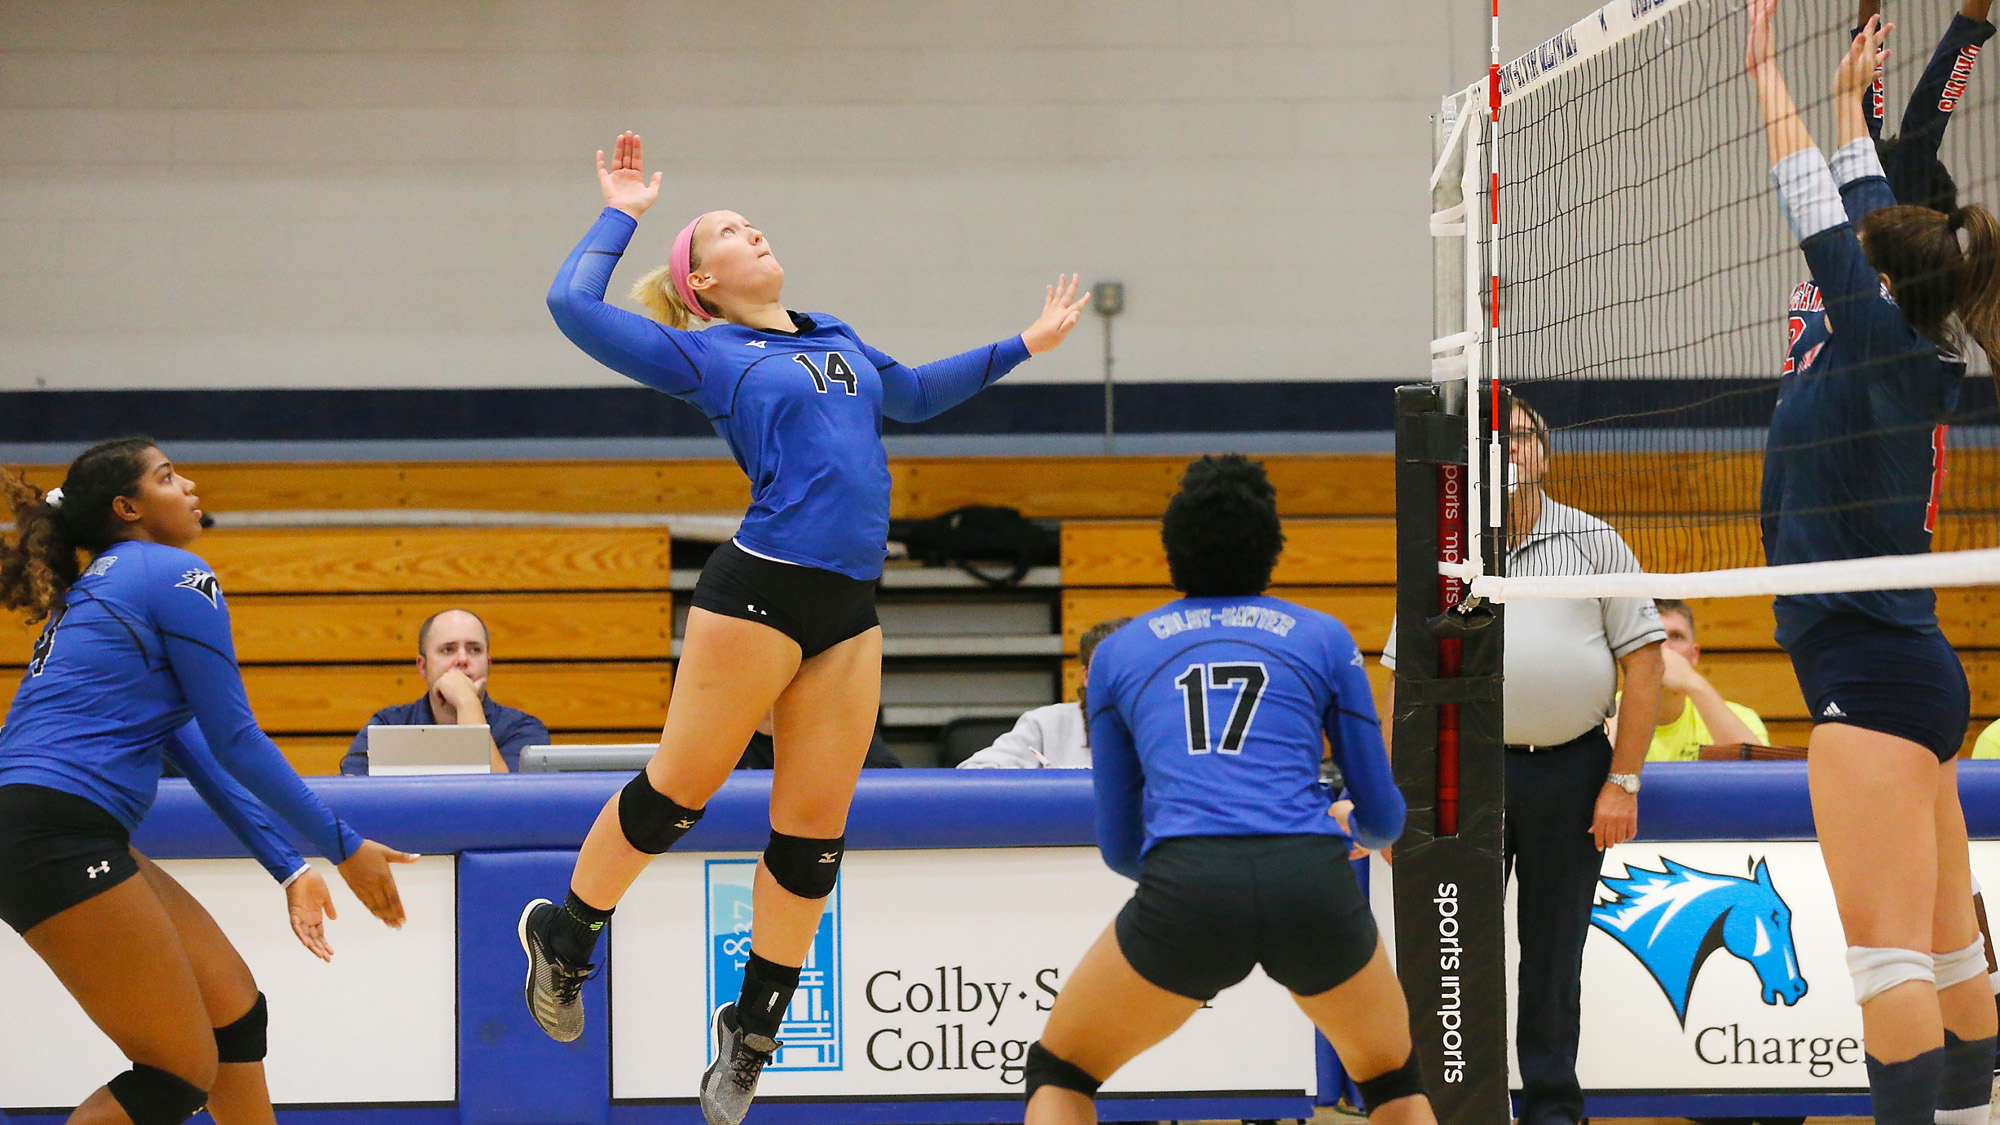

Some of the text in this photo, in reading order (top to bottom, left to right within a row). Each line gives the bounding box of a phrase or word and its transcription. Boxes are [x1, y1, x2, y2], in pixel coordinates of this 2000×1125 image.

[792, 351, 858, 396] 14
[1442, 465, 1460, 604] ports imprts
[1175, 661, 1270, 756] 17
[866, 966, 1060, 1026] Colby·S
[1433, 882, 1466, 1084] sports imports
[866, 1024, 1028, 1085] Colleg
[1695, 1023, 1866, 1078] Charge
